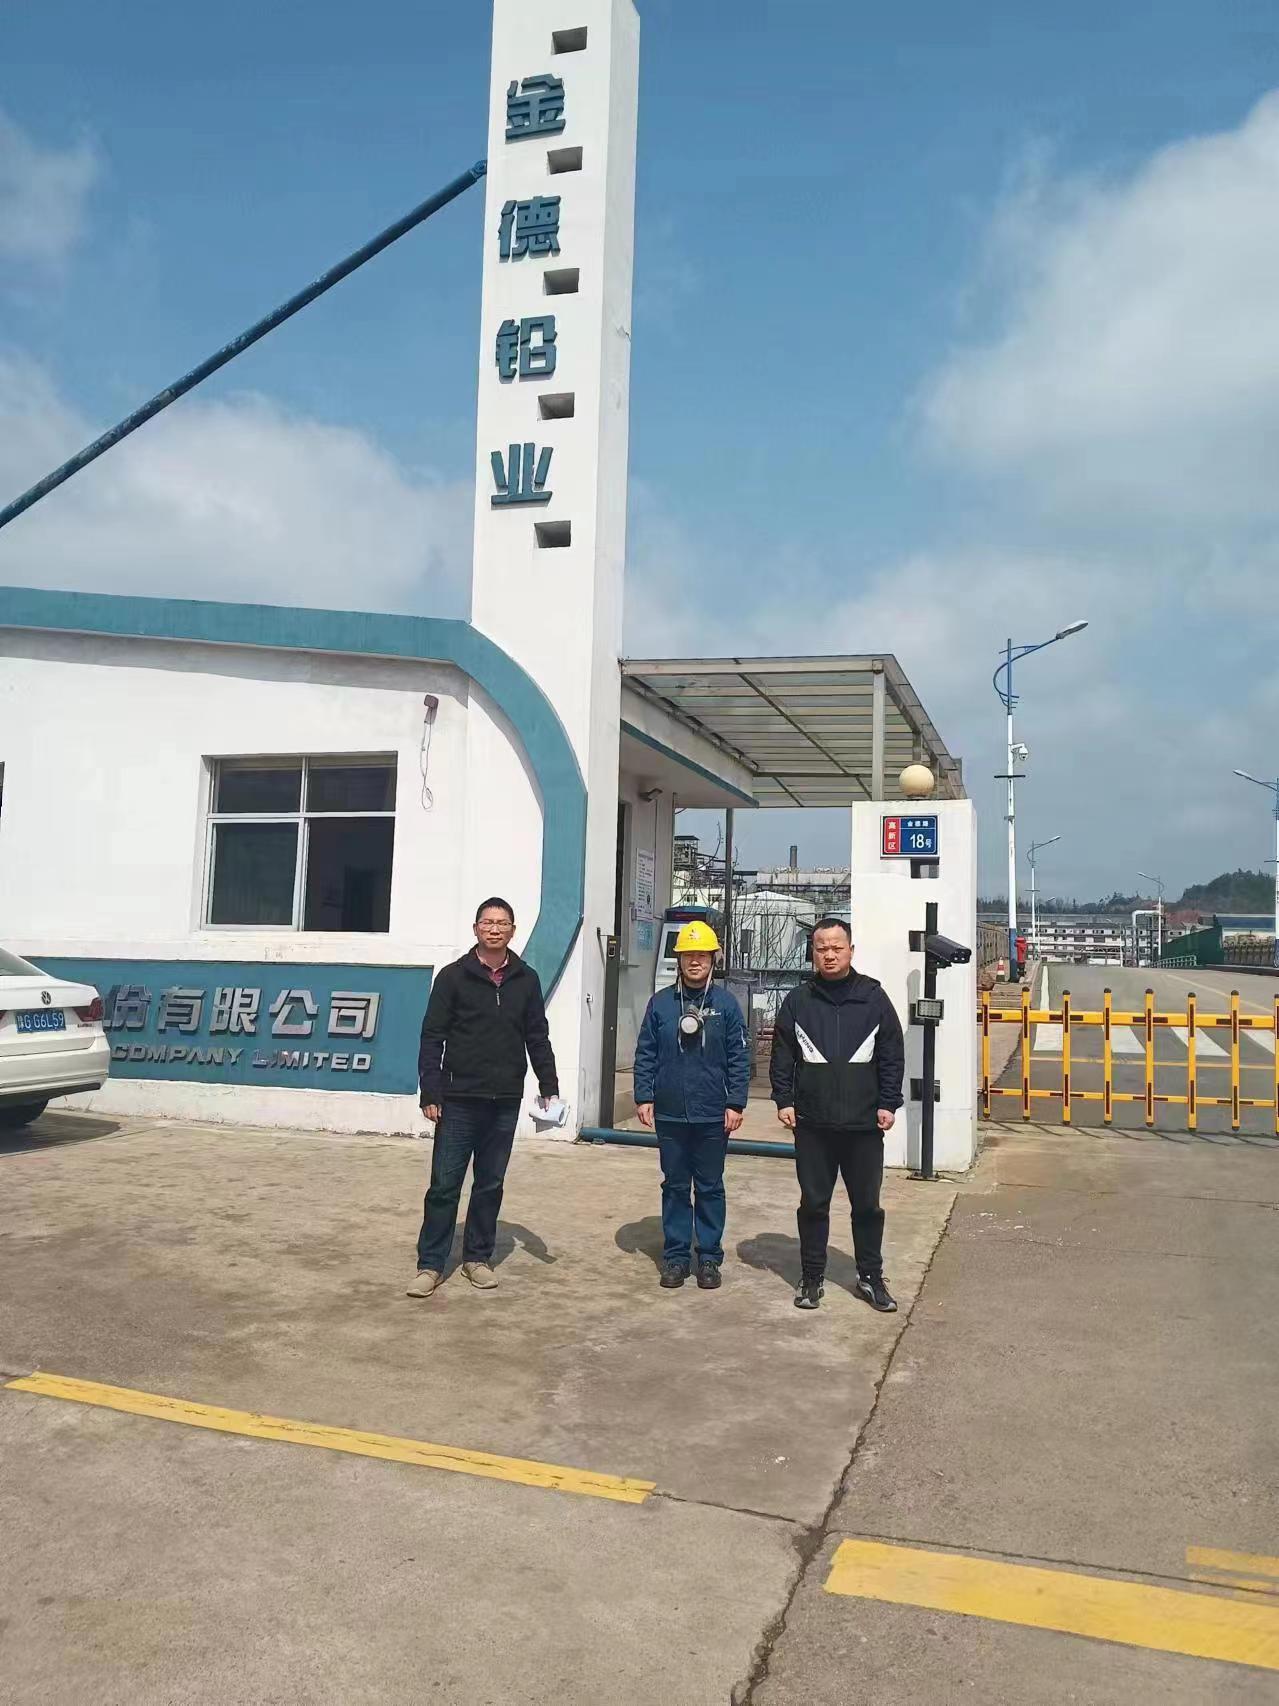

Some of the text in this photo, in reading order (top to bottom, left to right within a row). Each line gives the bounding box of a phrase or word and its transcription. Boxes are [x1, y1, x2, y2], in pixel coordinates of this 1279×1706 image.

[491, 73, 566, 506] 金德铅业
[910, 833, 932, 849] 18号
[111, 1043, 373, 1072] COMPANY LIMITED
